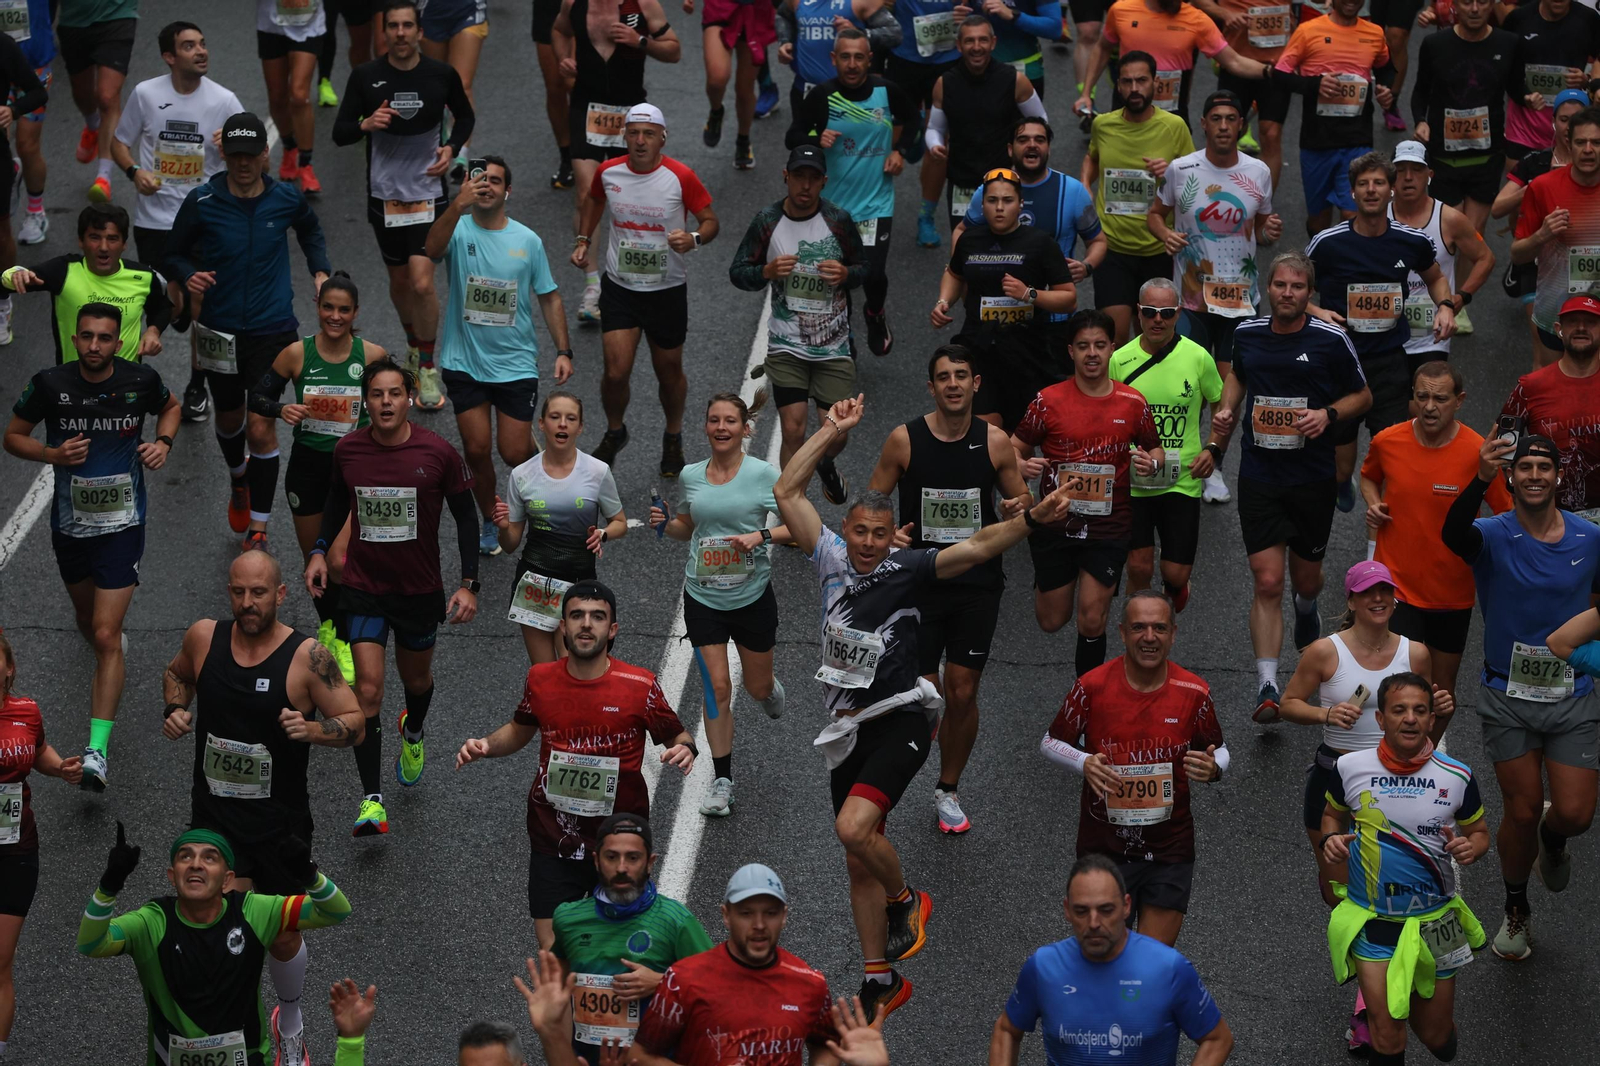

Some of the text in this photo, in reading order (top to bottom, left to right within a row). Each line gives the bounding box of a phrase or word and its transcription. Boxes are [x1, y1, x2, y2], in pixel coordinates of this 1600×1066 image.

[1255, 16, 1283, 29] 5835
[1532, 74, 1562, 89] 6594
[227, 128, 257, 137] adidas
[1450, 119, 1478, 133] 3724
[163, 132, 201, 142] TRIATLÓN
[1111, 181, 1144, 195] 9044
[629, 208, 665, 218] SEVILLA
[625, 251, 657, 266] 9554
[967, 254, 1023, 264] WASHINGTON
[791, 274, 824, 292] 8708
[473, 288, 507, 306] 8614
[1356, 296, 1389, 310] 4848
[311, 399, 348, 414] 5934
[60, 413, 139, 431] SAN ANTÓN
[1259, 410, 1294, 426] 4889
[80, 489, 119, 505] 9029
[365, 501, 402, 518] 8439
[930, 503, 969, 519] 7653
[703, 550, 741, 567] 9904
[828, 639, 869, 665] 15647
[1521, 659, 1561, 678] 8372
[1118, 736, 1172, 753] MEDIO
[212, 752, 255, 776] 7542
[558, 767, 603, 791] 7762
[1371, 776, 1436, 790] FONTANA
[1379, 782, 1426, 797] Service
[1401, 882, 1434, 895] RUN
[580, 992, 622, 1015] 4308
[781, 1003, 799, 1011] HOKA
[1059, 1023, 1108, 1055] Atmósfera
